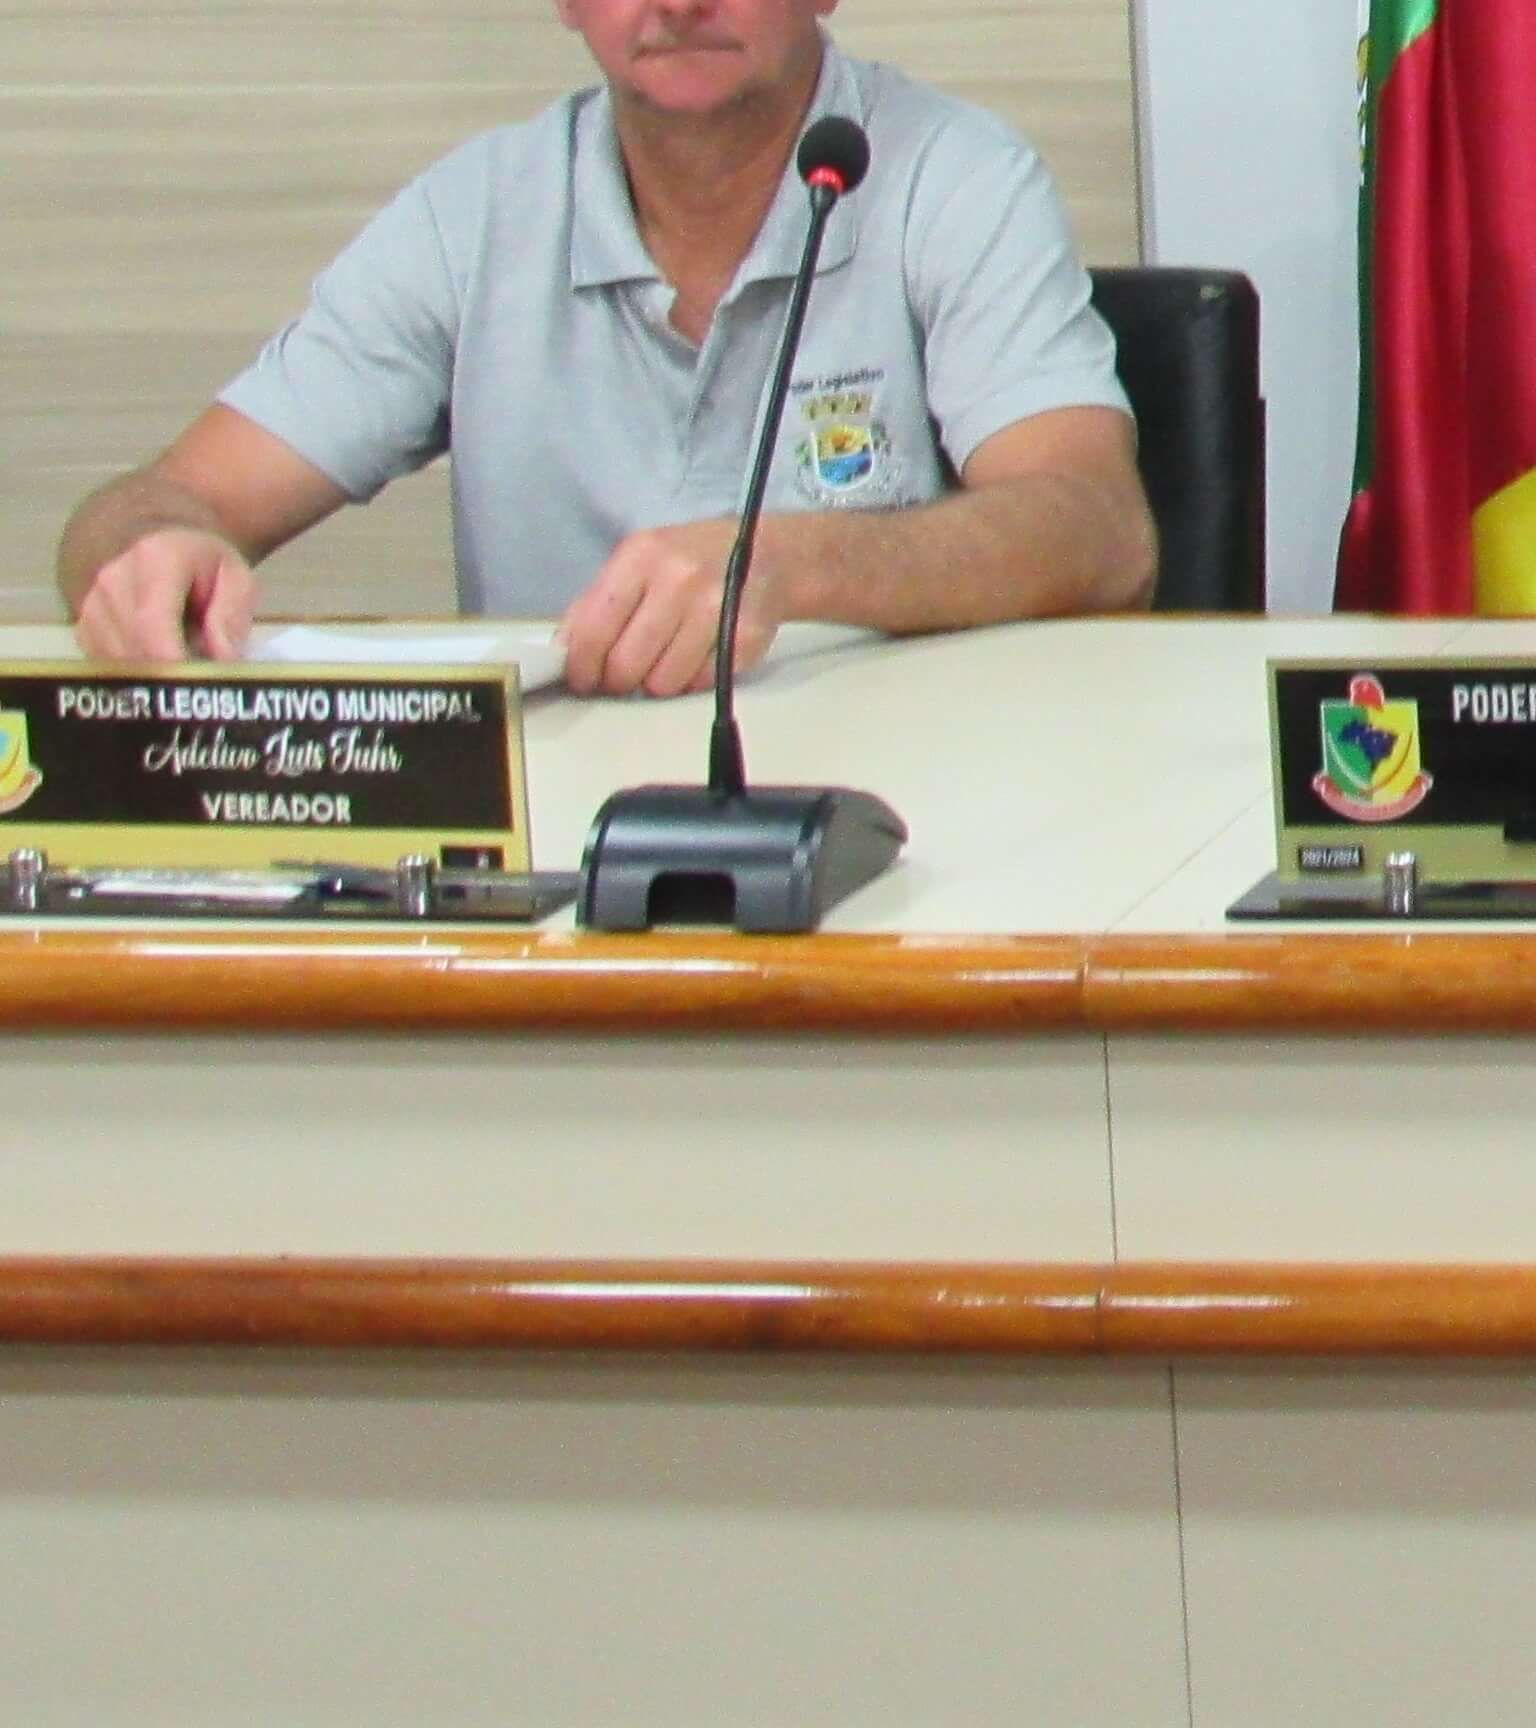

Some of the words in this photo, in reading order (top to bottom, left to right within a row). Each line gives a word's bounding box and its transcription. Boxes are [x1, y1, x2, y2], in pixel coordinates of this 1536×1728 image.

[58, 687, 152, 720] PODER
[157, 688, 330, 721] LEGISLATIVO
[337, 689, 482, 723] MUNICIPAL
[201, 792, 352, 823] VEREADOR
